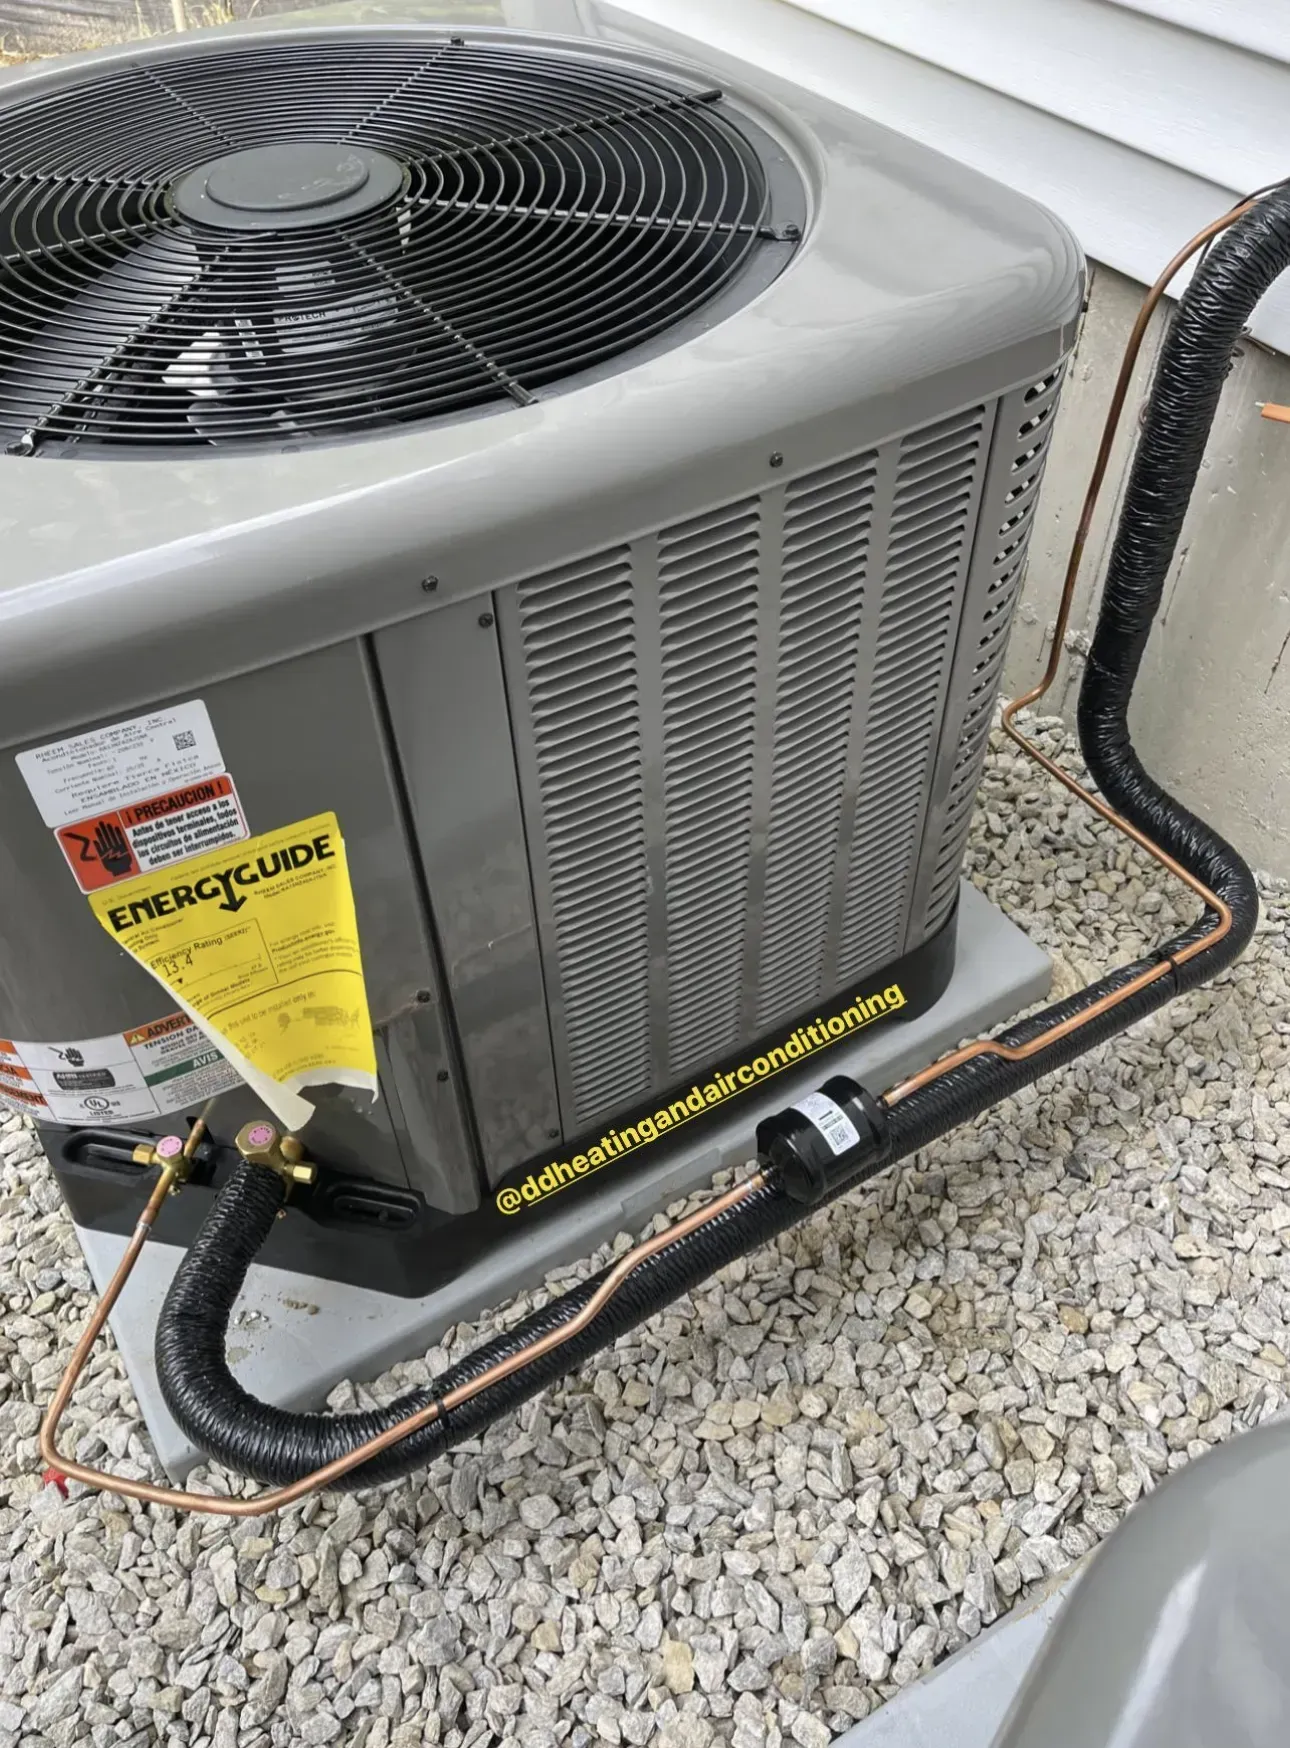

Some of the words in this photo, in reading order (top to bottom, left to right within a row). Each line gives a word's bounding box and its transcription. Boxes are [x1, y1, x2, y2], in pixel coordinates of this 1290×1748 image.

[145, 717, 177, 731] Central
[35, 746, 64, 760] RHEEM
[68, 737, 96, 749] SALES
[132, 824, 154, 837] Antes
[155, 820, 164, 830] de
[164, 814, 185, 827] tener
[186, 805, 211, 820] acceso
[212, 803, 218, 811] a
[218, 799, 230, 809] los
[134, 784, 215, 822] PRECAUCION
[217, 781, 224, 795] !
[132, 828, 176, 849] dispositivos
[176, 816, 217, 835] terminales,
[216, 808, 237, 821] todos
[137, 848, 150, 859] los
[150, 837, 182, 854] circuitos
[183, 833, 193, 843] de
[193, 818, 239, 838] alimentación
[148, 852, 172, 866] deben
[172, 847, 184, 859] ser
[184, 831, 236, 853] interrumpidos.
[107, 833, 336, 933] ENERGYGUIDE
[150, 945, 192, 971] Efficiency
[193, 937, 223, 951] Rating
[162, 953, 194, 978] 13.4
[144, 1031, 184, 1050] TENSION
[192, 1051, 219, 1069] AVIS
